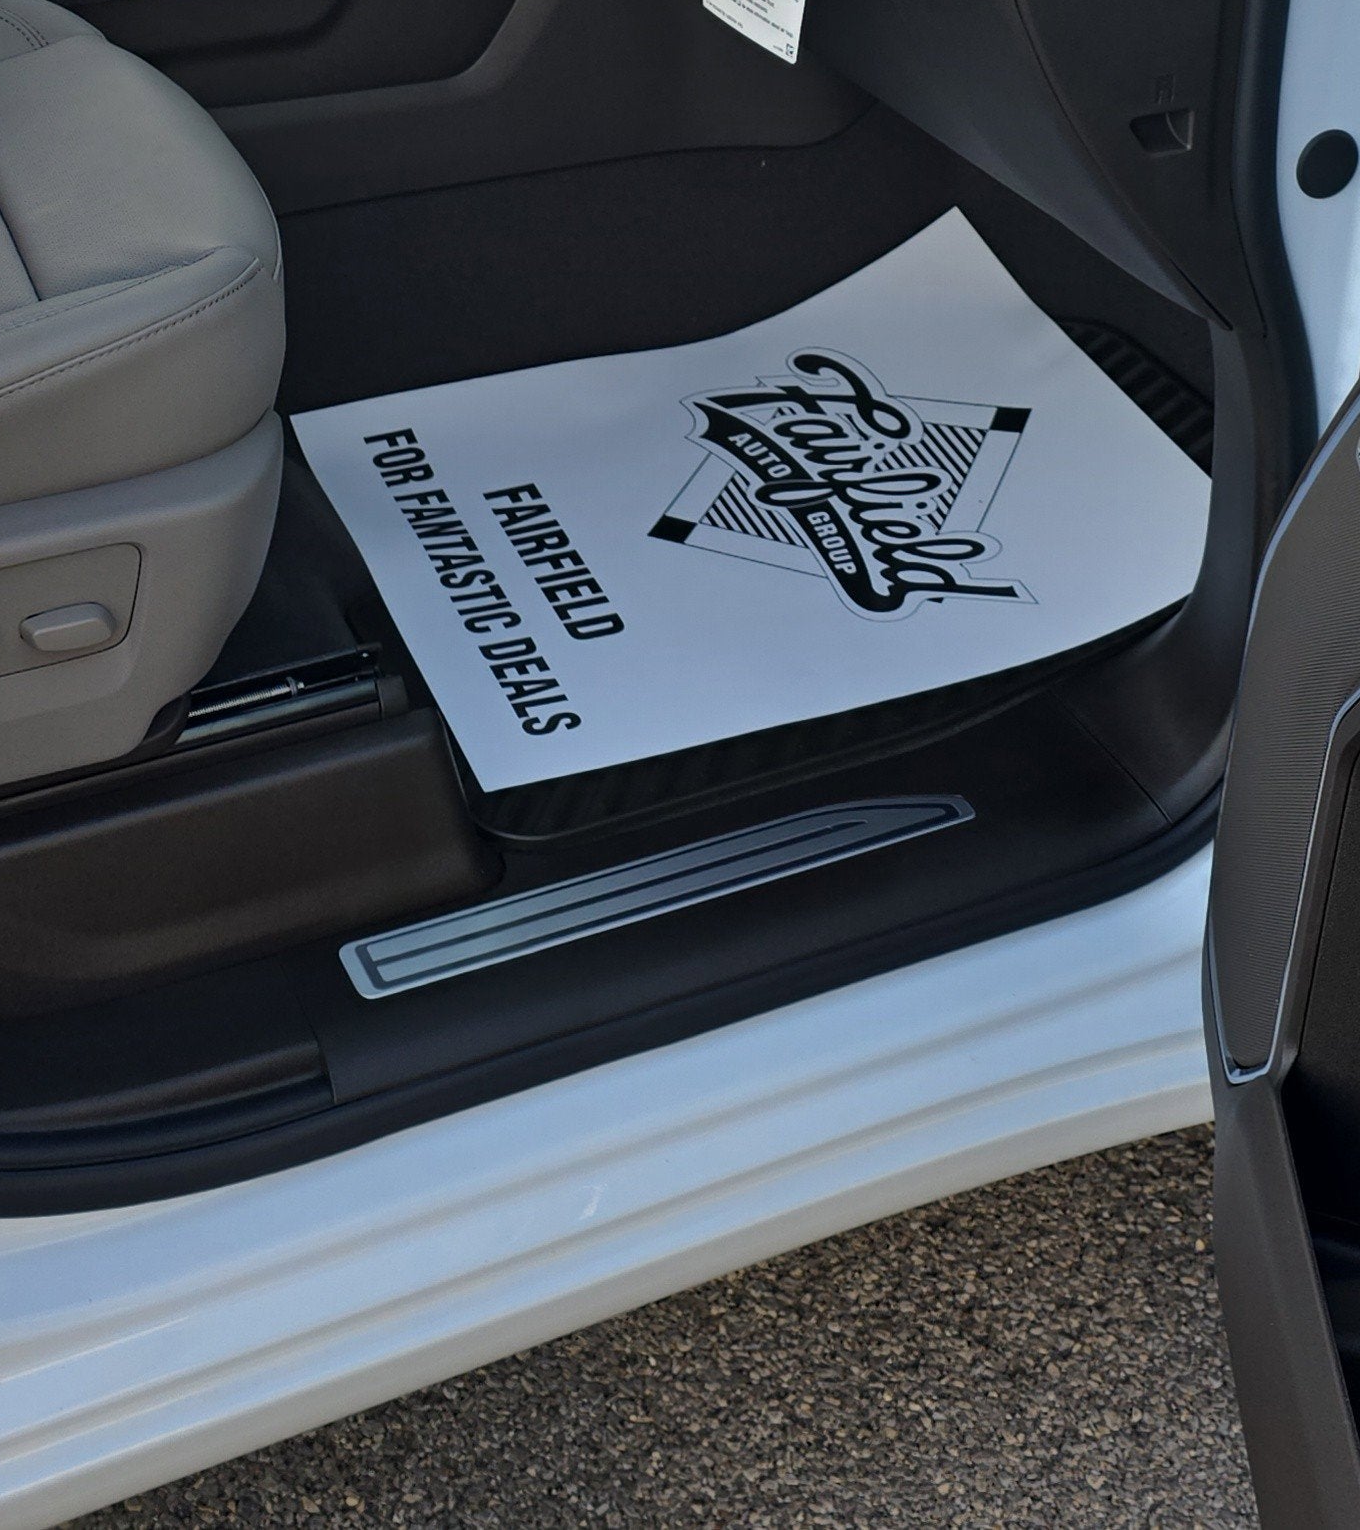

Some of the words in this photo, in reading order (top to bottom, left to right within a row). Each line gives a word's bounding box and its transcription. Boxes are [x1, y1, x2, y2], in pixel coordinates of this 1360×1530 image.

[363, 428, 435, 488] FOR
[707, 353, 1019, 612] Fairfield
[728, 433, 792, 480] AUTO
[393, 488, 522, 634] FANTASTIC
[483, 483, 625, 641] FAIRFIELD
[807, 511, 858, 575] GROUP
[478, 636, 582, 736] DEALS
